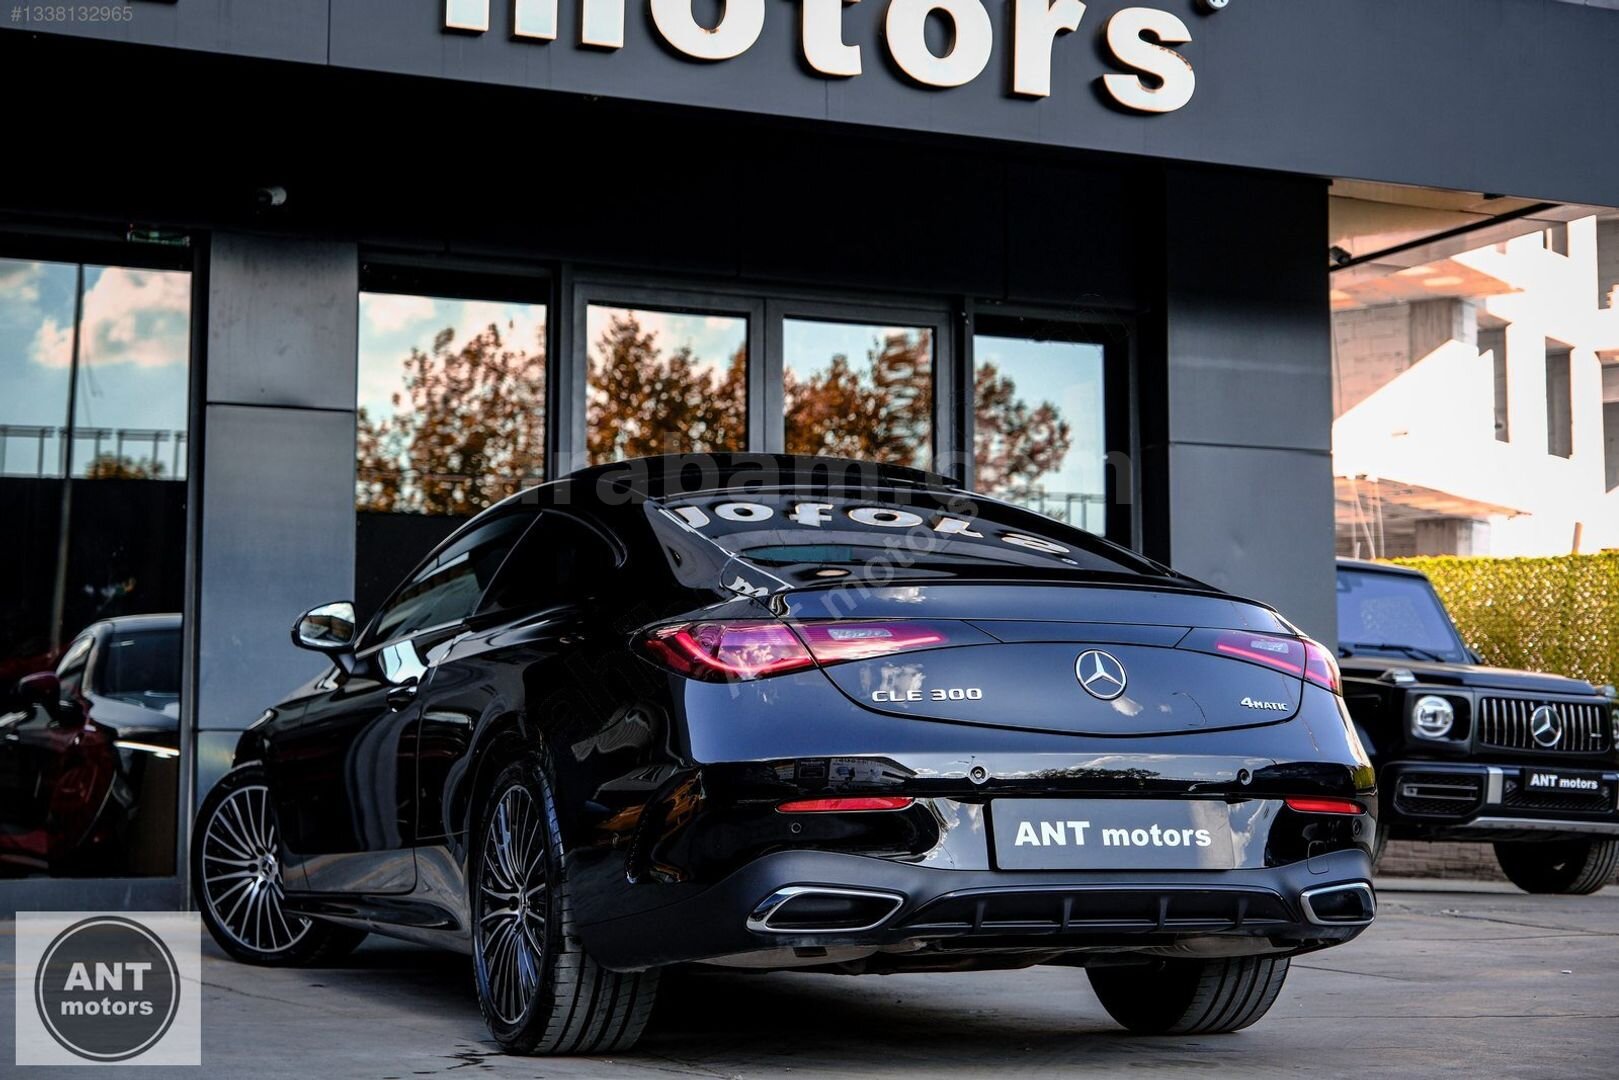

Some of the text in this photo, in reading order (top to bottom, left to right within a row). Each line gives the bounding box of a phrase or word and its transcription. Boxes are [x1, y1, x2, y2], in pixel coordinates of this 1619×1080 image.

[871, 687, 983, 703] CLE 300
[1240, 696, 1289, 712] 4MATIC
[1530, 773, 1598, 790] ANT motors
[1014, 820, 1212, 847] ANT motors
